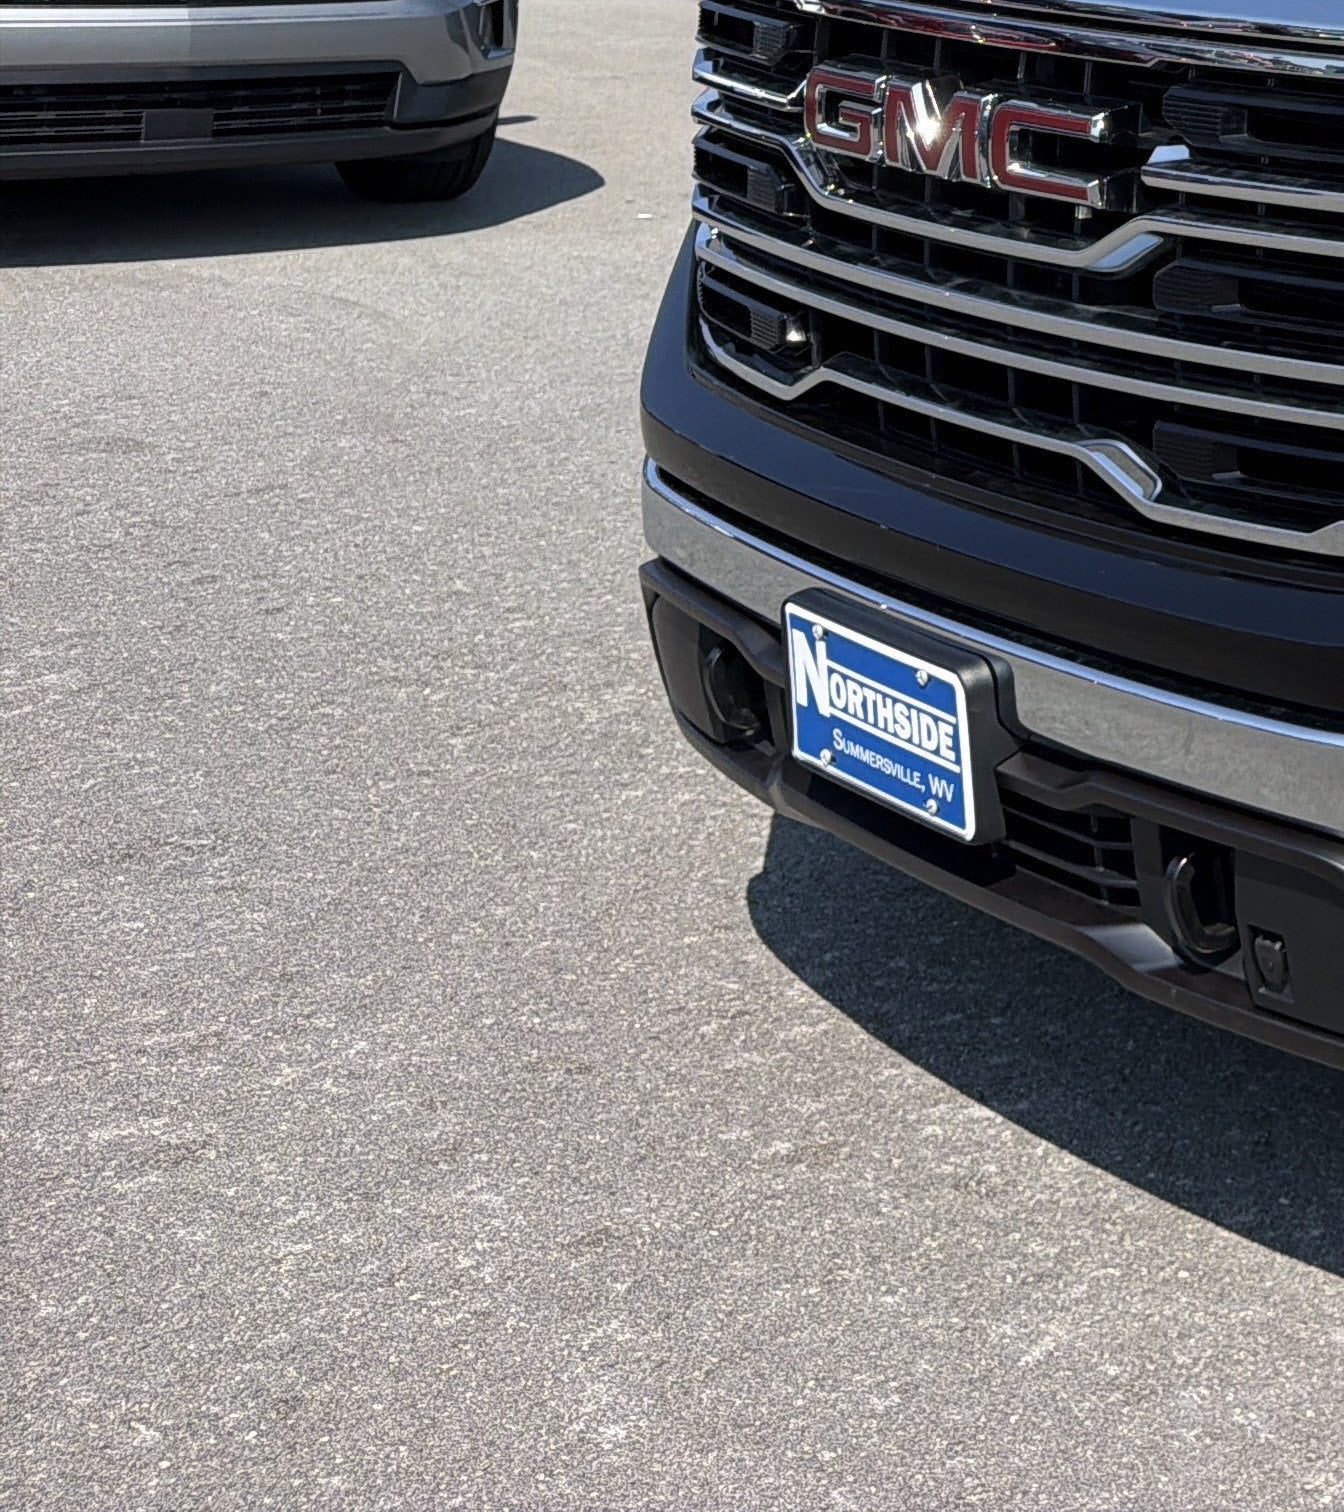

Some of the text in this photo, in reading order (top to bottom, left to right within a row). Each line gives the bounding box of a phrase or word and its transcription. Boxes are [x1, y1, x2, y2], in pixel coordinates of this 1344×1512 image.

[803, 68, 1104, 209] GMC
[792, 627, 957, 762] NORTHSIDE
[832, 728, 955, 803] SUMMERSVILLE, WV
